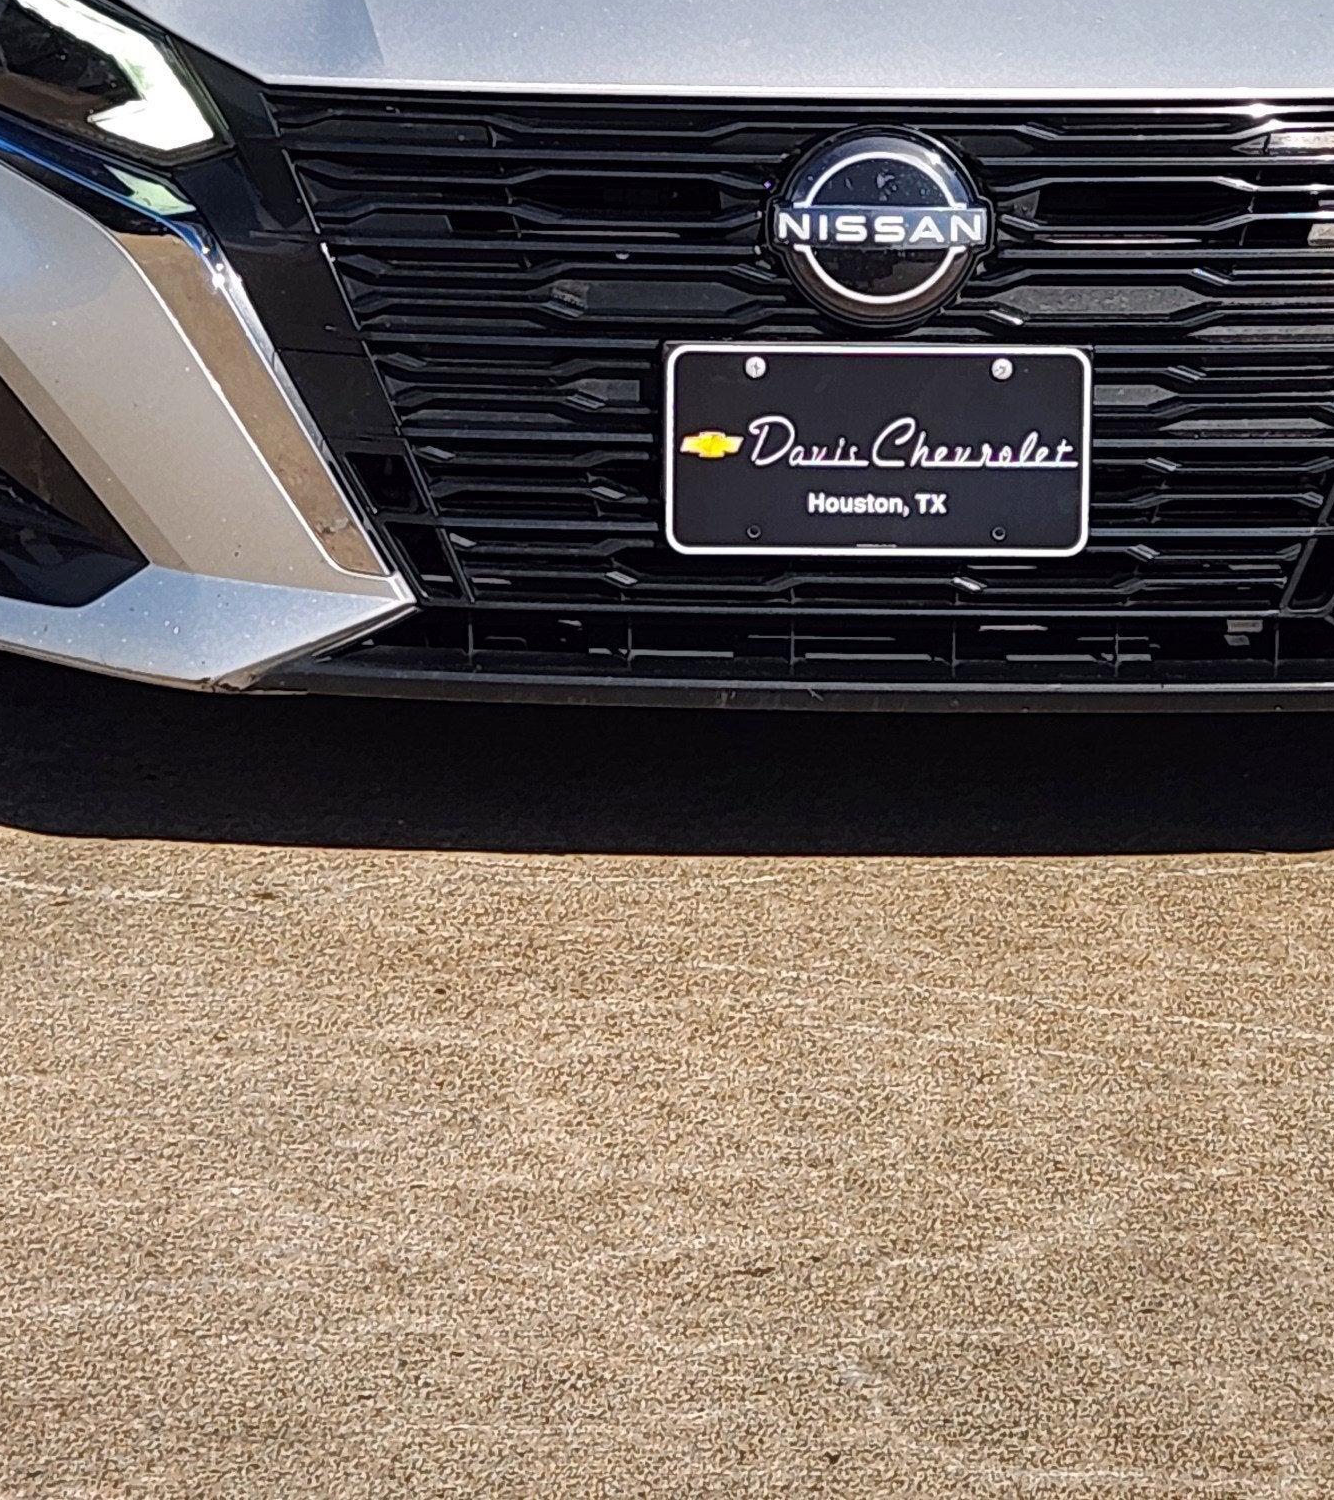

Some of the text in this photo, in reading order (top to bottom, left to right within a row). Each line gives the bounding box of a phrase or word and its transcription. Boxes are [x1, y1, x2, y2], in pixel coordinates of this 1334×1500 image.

[777, 213, 982, 244] NISSAN
[748, 415, 1079, 468] Davis Chevrolet
[807, 493, 948, 517] Houston, TX
